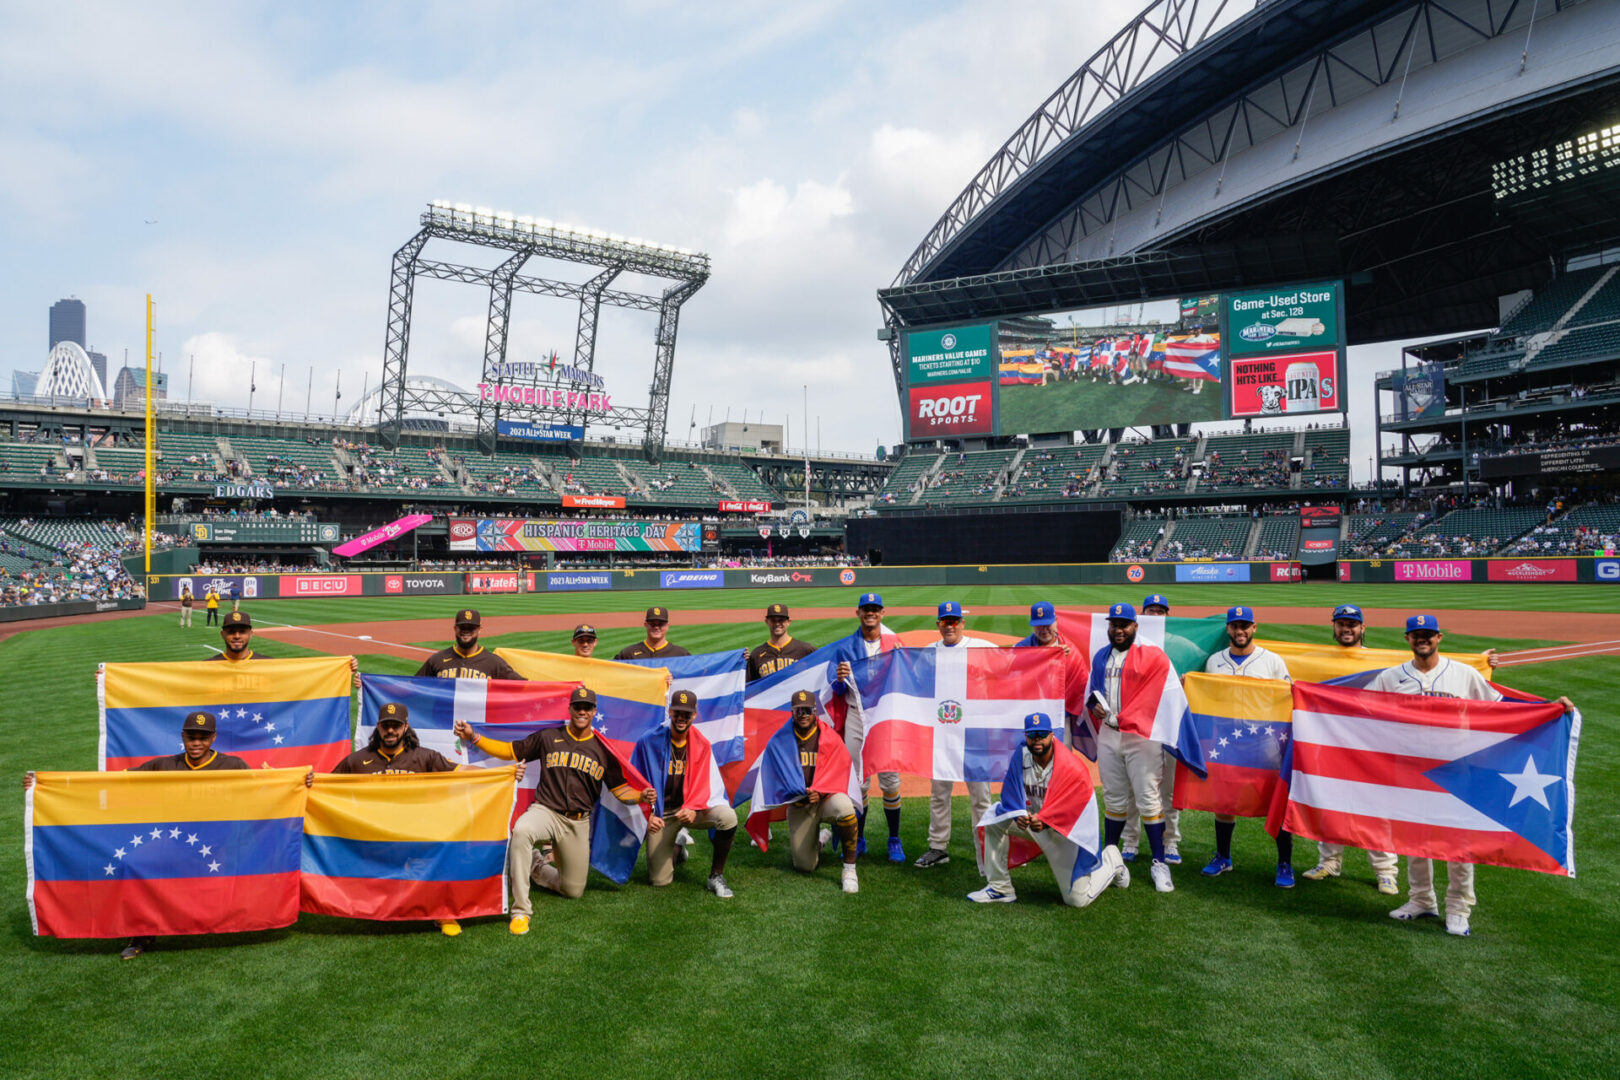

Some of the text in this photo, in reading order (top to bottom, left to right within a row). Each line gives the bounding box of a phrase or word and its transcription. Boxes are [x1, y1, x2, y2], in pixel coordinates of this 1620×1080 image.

[1233, 291, 1331, 311] Game-Used Store
[1261, 306, 1304, 319] at Sec. 128
[911, 349, 987, 363] MARINERS VALUE GAMES
[491, 361, 536, 378] SEATTLE
[918, 361, 940, 370] TICKETS
[939, 359, 964, 369] STARTING
[971, 358, 980, 366] $10
[1236, 362, 1276, 375] NOTHING
[560, 363, 605, 389] MARINERS
[926, 368, 972, 378] MARINERS.COM/VALUE
[1236, 375, 1257, 385] HITS
[1287, 378, 1317, 400] IPA
[477, 383, 613, 412] T-MOBILE PARK
[919, 394, 982, 418] ROOT
[930, 414, 974, 426] SPORTS
[509, 427, 526, 436] 2023
[553, 430, 572, 440] WEEK
[1540, 459, 1570, 467] DIFFERENT
[1540, 465, 1568, 473] AMERICAN
[215, 485, 274, 499] EDGARS
[524, 524, 668, 538] HISPANIC HERITAGE DAY
[587, 539, 614, 549] Mobile
[842, 572, 853, 580] 76
[1130, 569, 1142, 578] 76
[1191, 566, 1219, 575] Alaska
[1416, 563, 1462, 578] Mobile
[406, 580, 444, 588] TOYOTA
[550, 577, 565, 585] 2023
[592, 576, 609, 584] WEEK
[751, 574, 790, 584] KeyBank
[546, 752, 605, 781] SAN DIEGO
